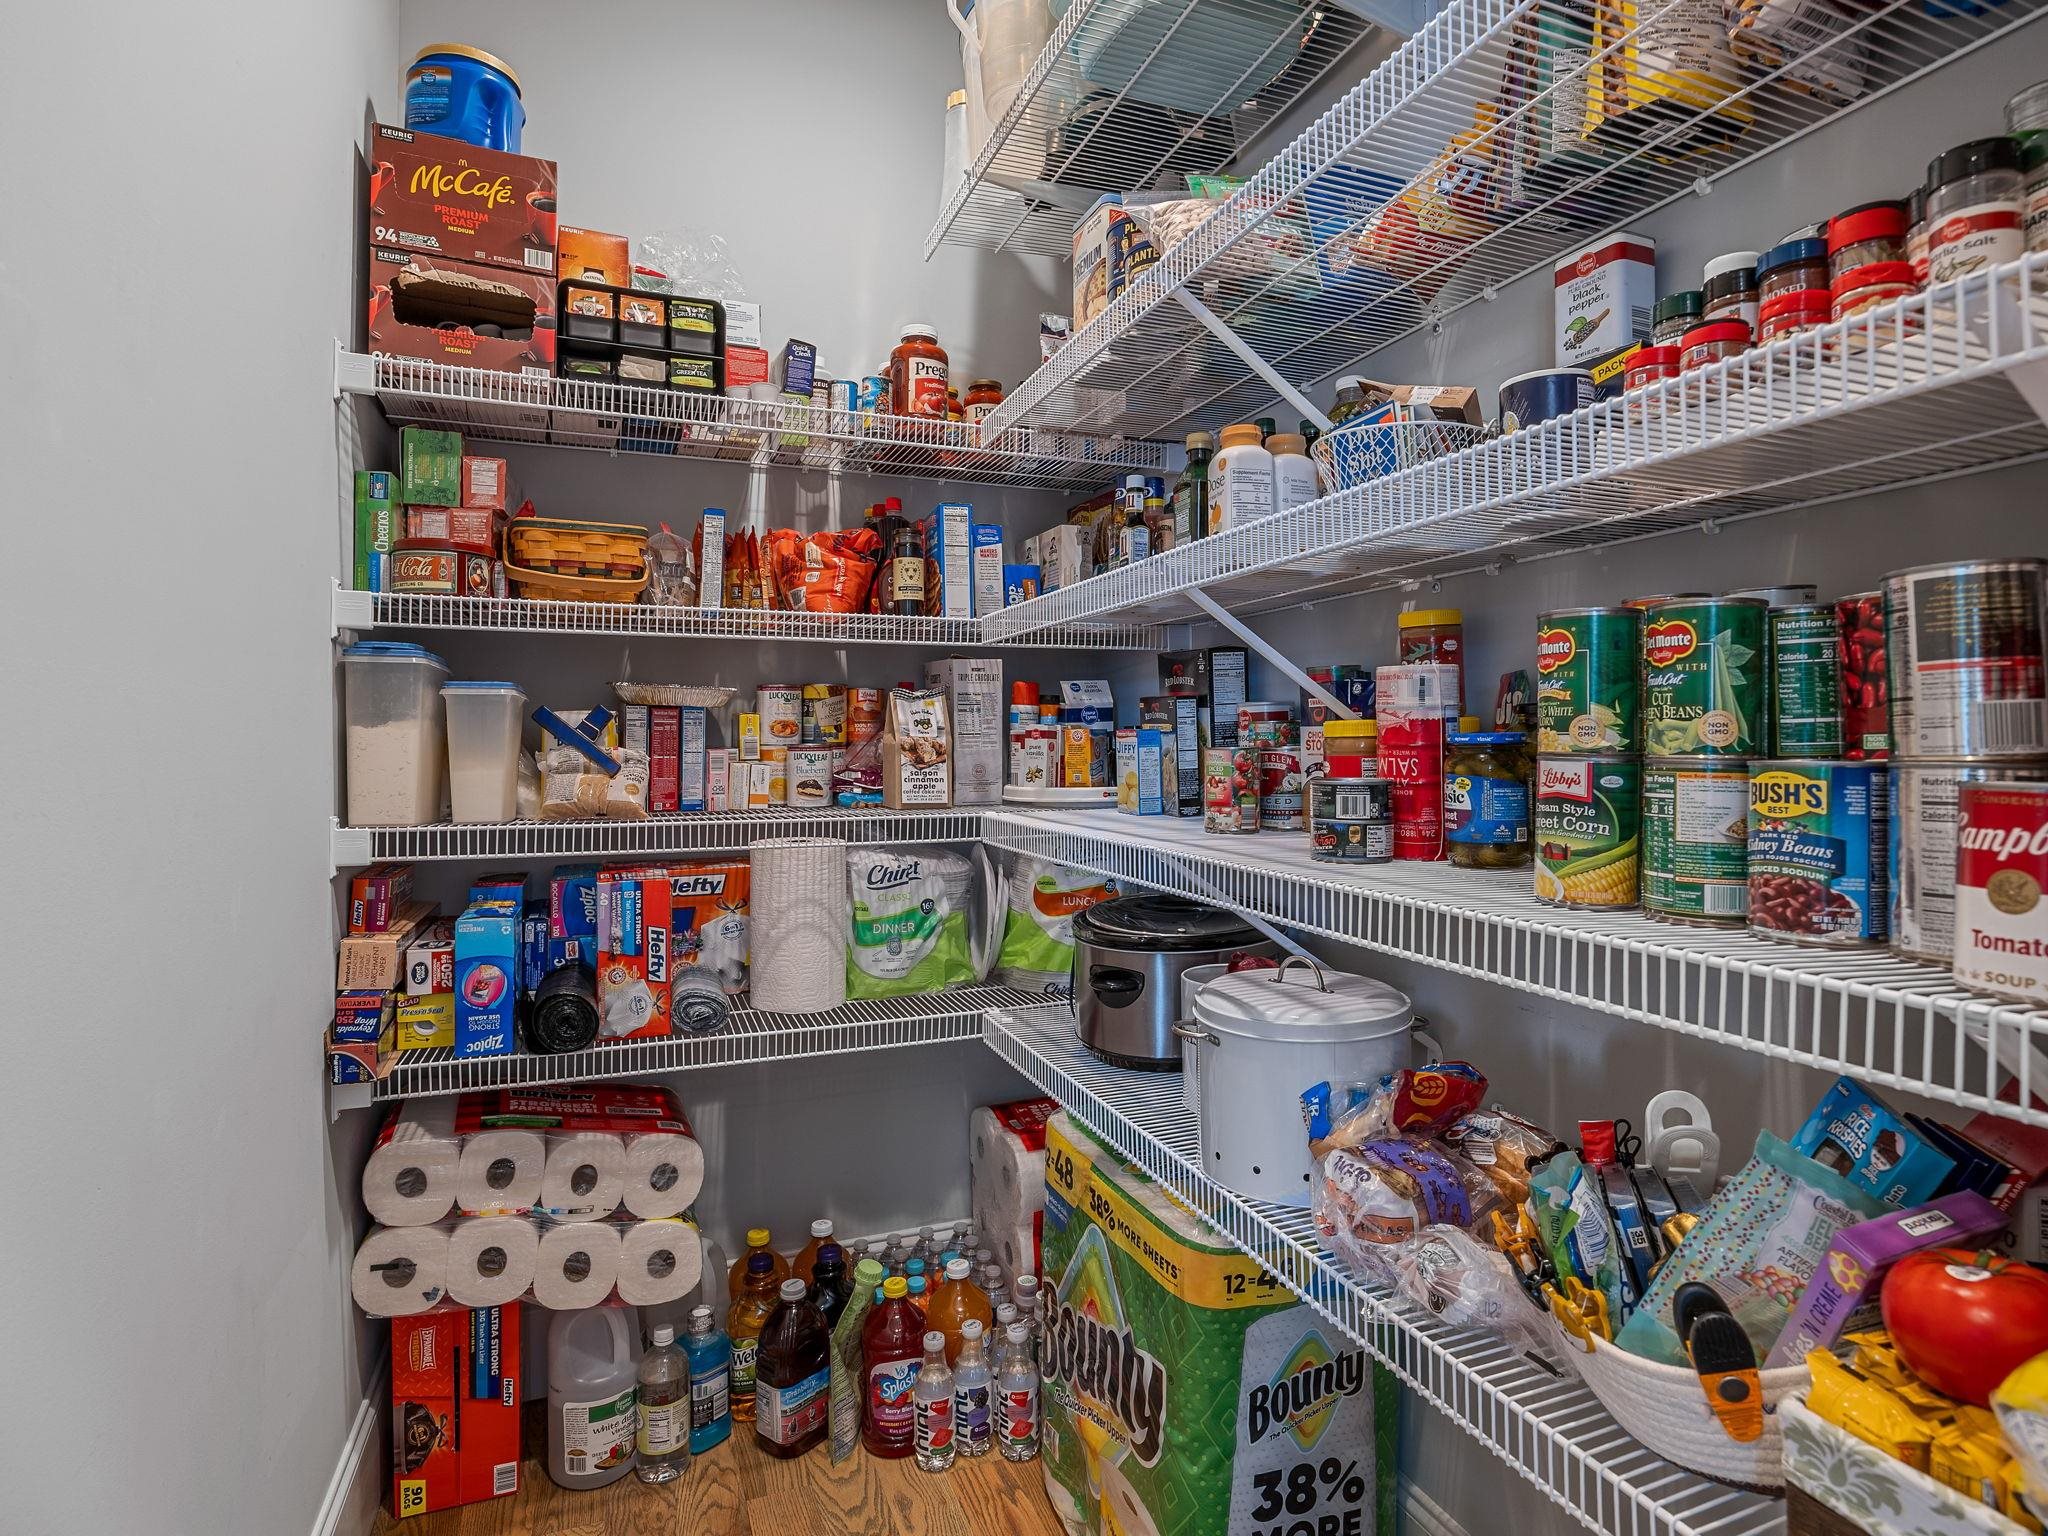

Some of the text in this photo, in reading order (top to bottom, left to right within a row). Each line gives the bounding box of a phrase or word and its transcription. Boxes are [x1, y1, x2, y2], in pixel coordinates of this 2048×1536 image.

[381, 128, 413, 140] KEURIG
[434, 204, 488, 222] PREMIUM
[442, 215, 481, 229] ROAST
[375, 226, 398, 243] 94
[448, 225, 474, 235] MEDIUM
[1963, 234, 1998, 251] salt
[378, 251, 410, 262] KEURIG
[1074, 245, 1101, 281] PREMIUM
[1578, 257, 1594, 269] Laura
[1580, 263, 1595, 272] Lynn
[1572, 283, 1601, 303] black
[1568, 292, 1606, 316] pepper
[439, 336, 478, 348] ROAST
[1656, 331, 1682, 343] ORGANIC
[445, 346, 472, 355] MEDIUM
[1598, 357, 1625, 377] PACK
[374, 510, 389, 552] Cheerios
[401, 556, 433, 576] Cola
[1778, 620, 1823, 630] Nutrition
[1541, 641, 1570, 654] Monte
[1656, 634, 1691, 647] Monte
[1653, 650, 1672, 659] Quality
[1778, 649, 1834, 661] Calories 20
[1676, 663, 1707, 671] WITH
[975, 673, 1000, 681] CHOCOLATE
[1652, 693, 1673, 705] CUT
[1547, 706, 1574, 717] WHITE
[1662, 706, 1703, 719] BEANS
[1708, 722, 1729, 730] NON
[1868, 735, 1885, 743] NON
[1117, 744, 1136, 753] JIFFY
[796, 766, 827, 775] Blueberry
[1542, 767, 1581, 788] Libby's
[913, 782, 936, 790] apple
[1751, 782, 1824, 808] BUSH'S
[1563, 804, 1596, 817] Style
[1651, 804, 1674, 815] 20 15
[1767, 806, 1790, 815] BEST
[1562, 817, 1610, 836] Corn
[1557, 830, 1597, 841] Goodness!
[1781, 833, 1799, 841] RED
[1782, 840, 1834, 859] Beans
[1768, 854, 1837, 870] ROJOS OSCUROS
[867, 861, 921, 886] Chinet
[1781, 866, 1829, 882] SODIUM
[580, 887, 597, 924] Ziploc
[600, 893, 608, 905] 40
[1063, 897, 1096, 906] LUNCH
[354, 900, 363, 925] Hefty
[873, 922, 915, 934] DINNER
[650, 929, 664, 980] Hefty
[370, 946, 379, 987] PARCHMENT
[379, 956, 387, 976] PAPER
[442, 966, 452, 987] 250
[1985, 971, 2036, 989] SOUP
[398, 997, 420, 1007] GLAD
[400, 1006, 444, 1016] Press'n Seal
[336, 1024, 374, 1033] Reynolds
[354, 1016, 377, 1027] Wrap
[466, 1034, 504, 1052] Ziploc
[510, 1101, 598, 1109] STRONGEST
[1845, 1112, 1871, 1138] RICE
[1827, 1119, 1868, 1160] KRISPIES
[2012, 1179, 2028, 1199] BARK
[1089, 1187, 1180, 1279] 38% MORE SHEETS
[1638, 1230, 1646, 1243] 35
[1810, 1281, 1842, 1324] CREME
[422, 1330, 434, 1368] EXPANDABLE
[491, 1308, 499, 1376] ULTRA STRONG
[1042, 1282, 1163, 1464] Bounty
[504, 1380, 513, 1405] Hefty
[882, 1372, 917, 1400] Splash
[1248, 1348, 1366, 1444] Bounty
[1056, 1388, 1126, 1444] The Quicker Picker Upper
[1269, 1397, 1339, 1441] The Quicker Picker Upper
[593, 1420, 620, 1435] white
[412, 1487, 423, 1506] 90
[1251, 1457, 1366, 1523] 38%
